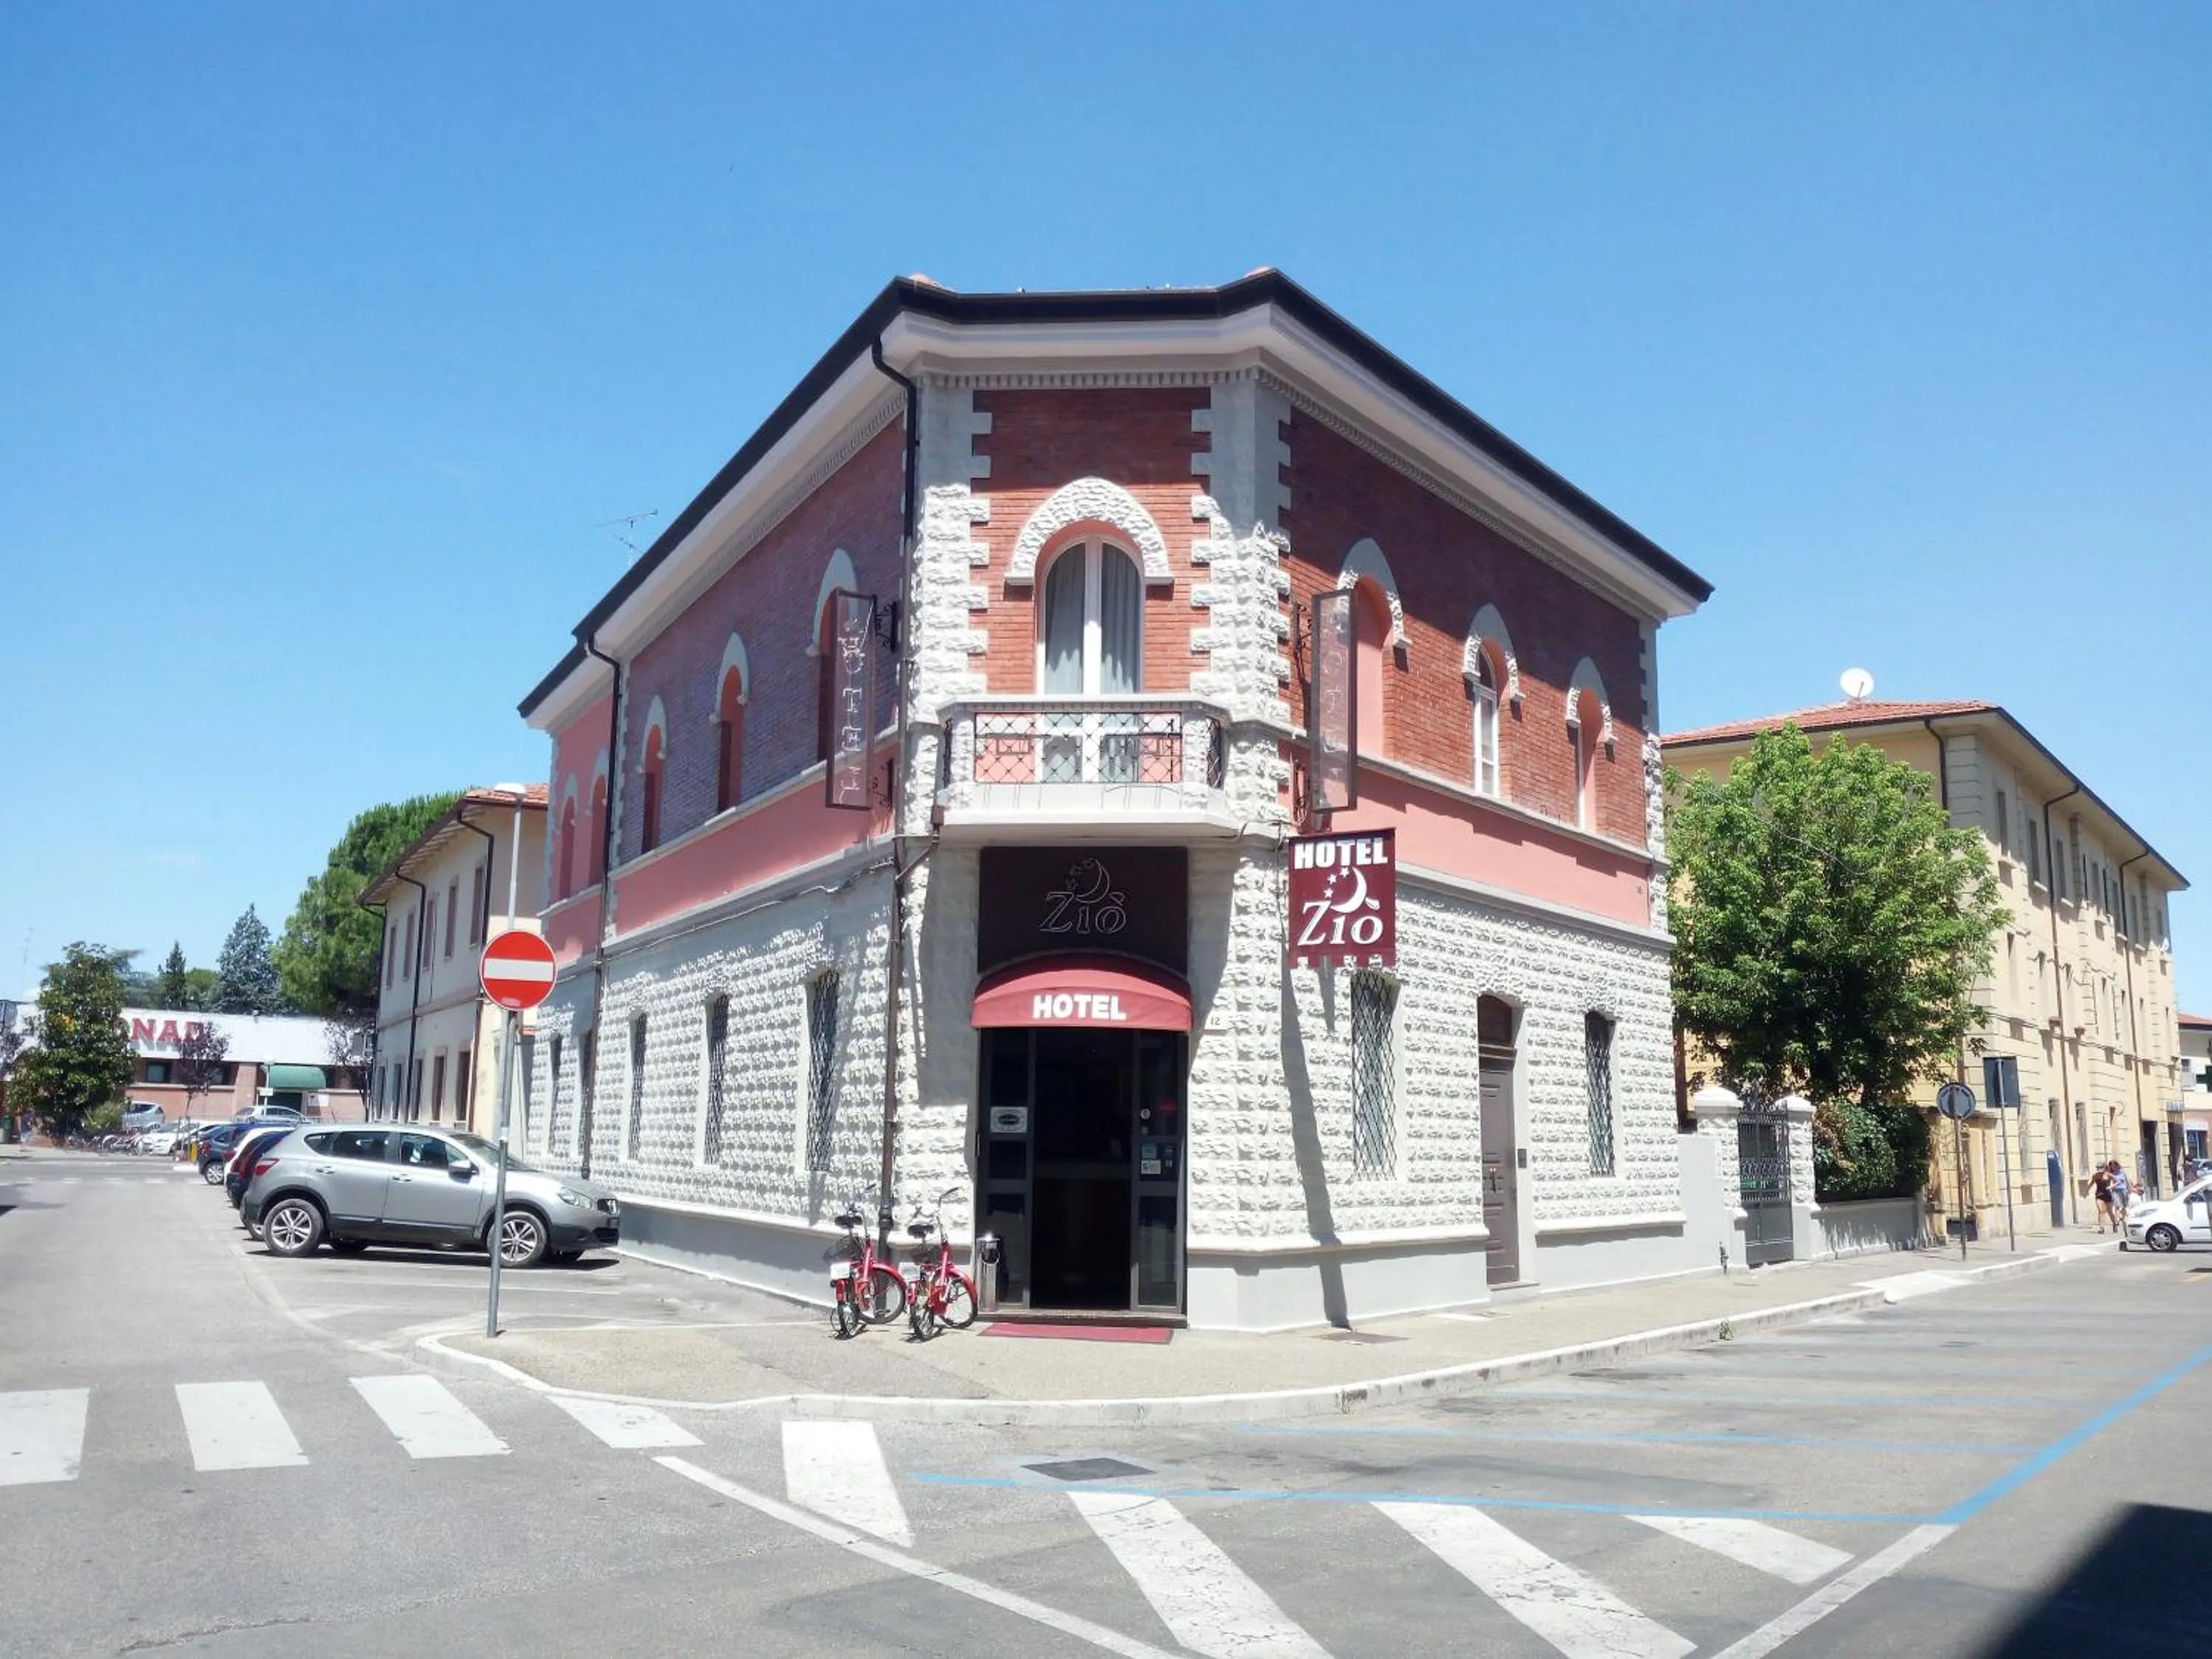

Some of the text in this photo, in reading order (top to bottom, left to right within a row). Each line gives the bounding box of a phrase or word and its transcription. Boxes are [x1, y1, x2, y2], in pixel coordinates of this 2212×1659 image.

[1294, 838, 1388, 869] HOTEL
[1032, 993, 1127, 1020] HOTEL
[118, 1017, 206, 1043] NAD
